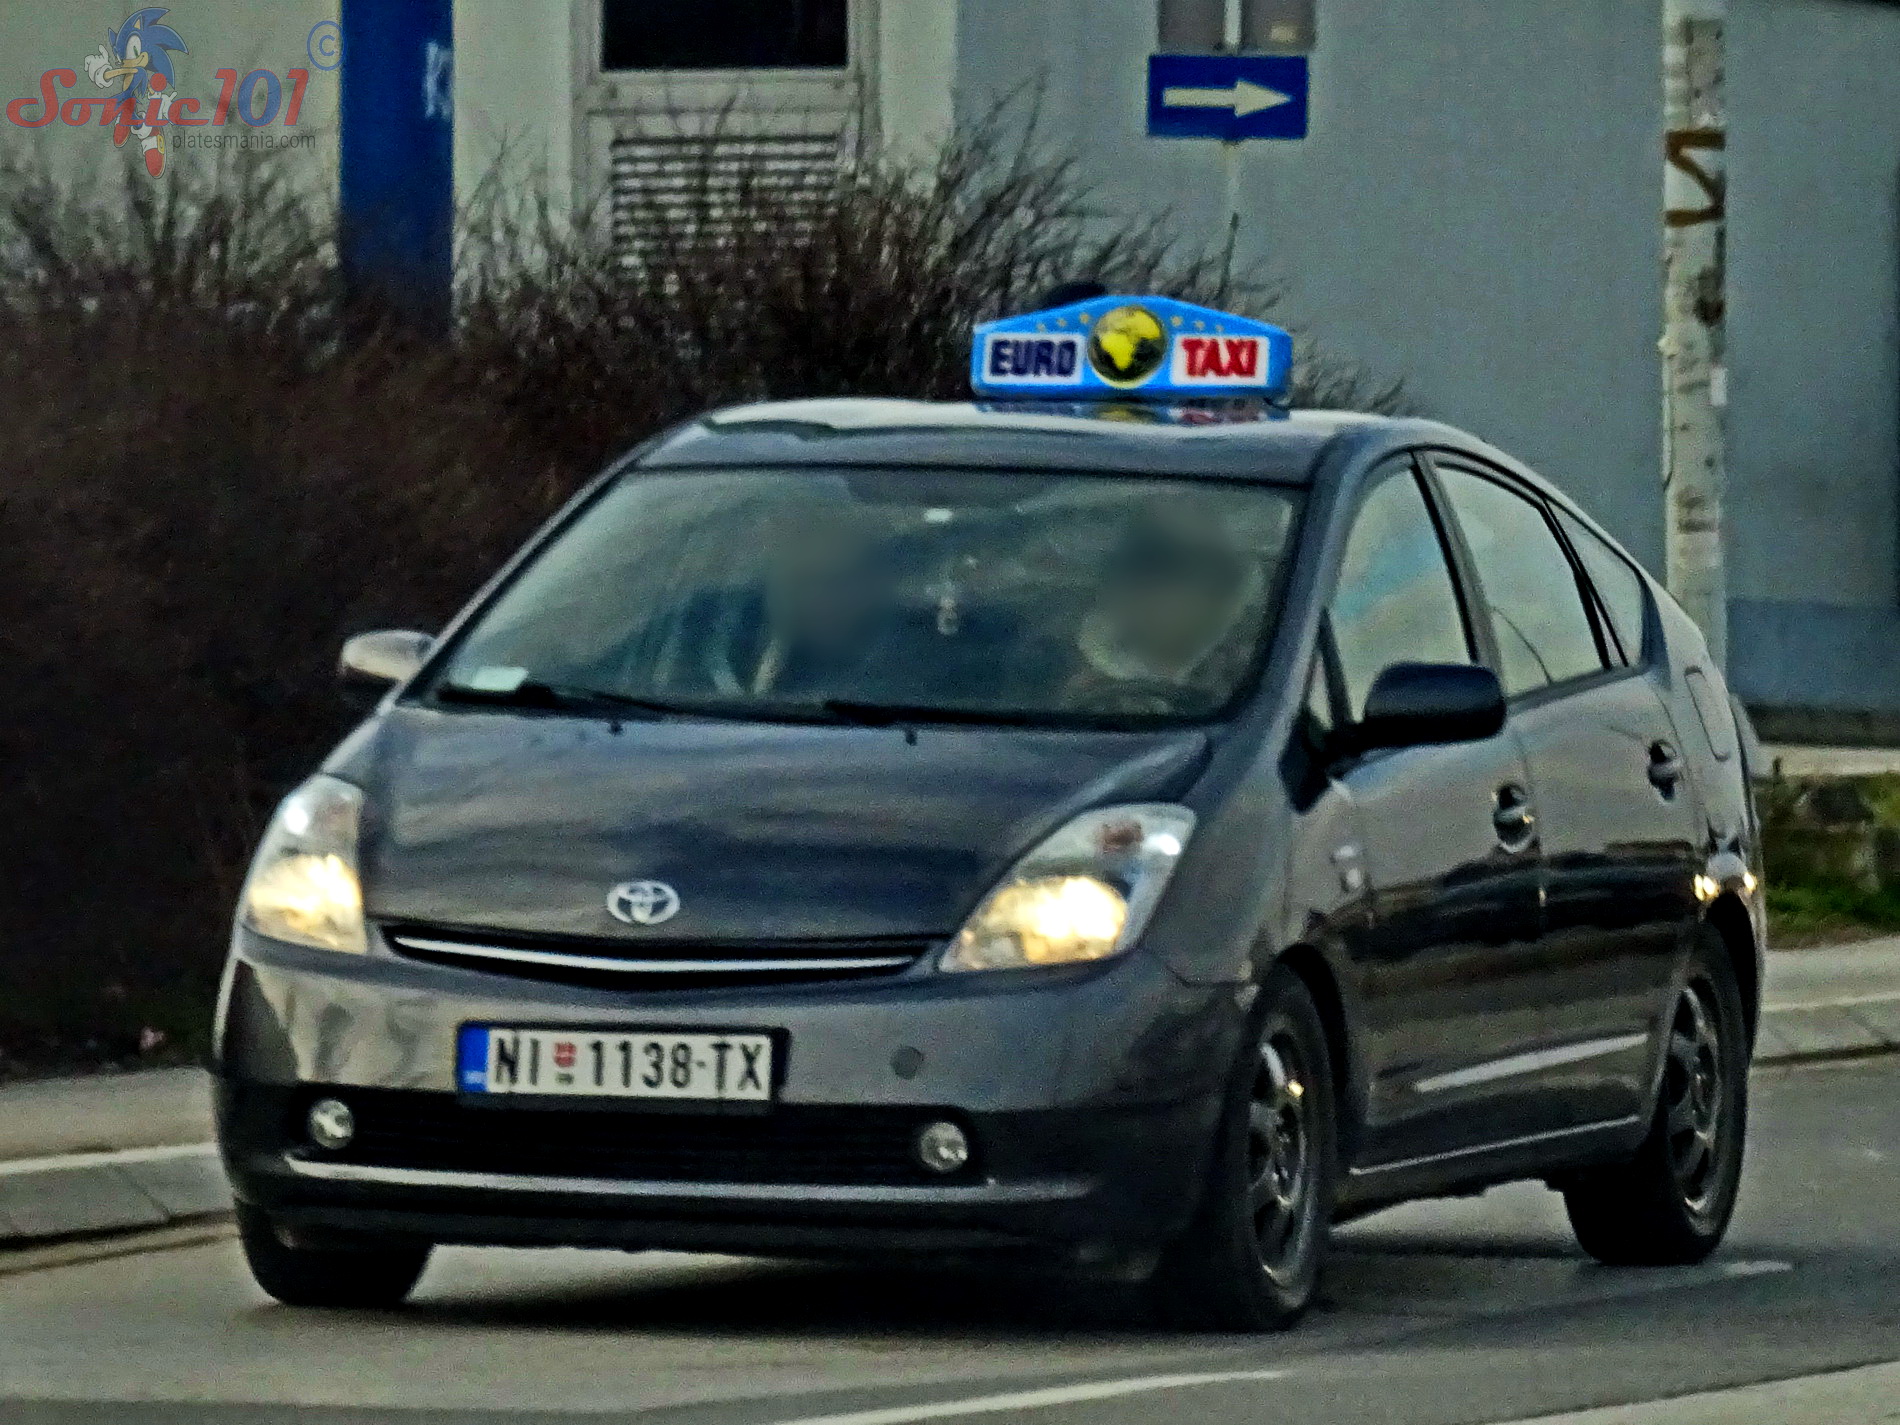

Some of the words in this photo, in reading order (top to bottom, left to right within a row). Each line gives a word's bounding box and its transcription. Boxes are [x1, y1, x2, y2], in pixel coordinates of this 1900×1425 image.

[989, 339, 1078, 377] EURO
[1181, 337, 1260, 378] TAXI
[495, 1036, 541, 1086] NI
[590, 1040, 763, 1092] 1138-TX
